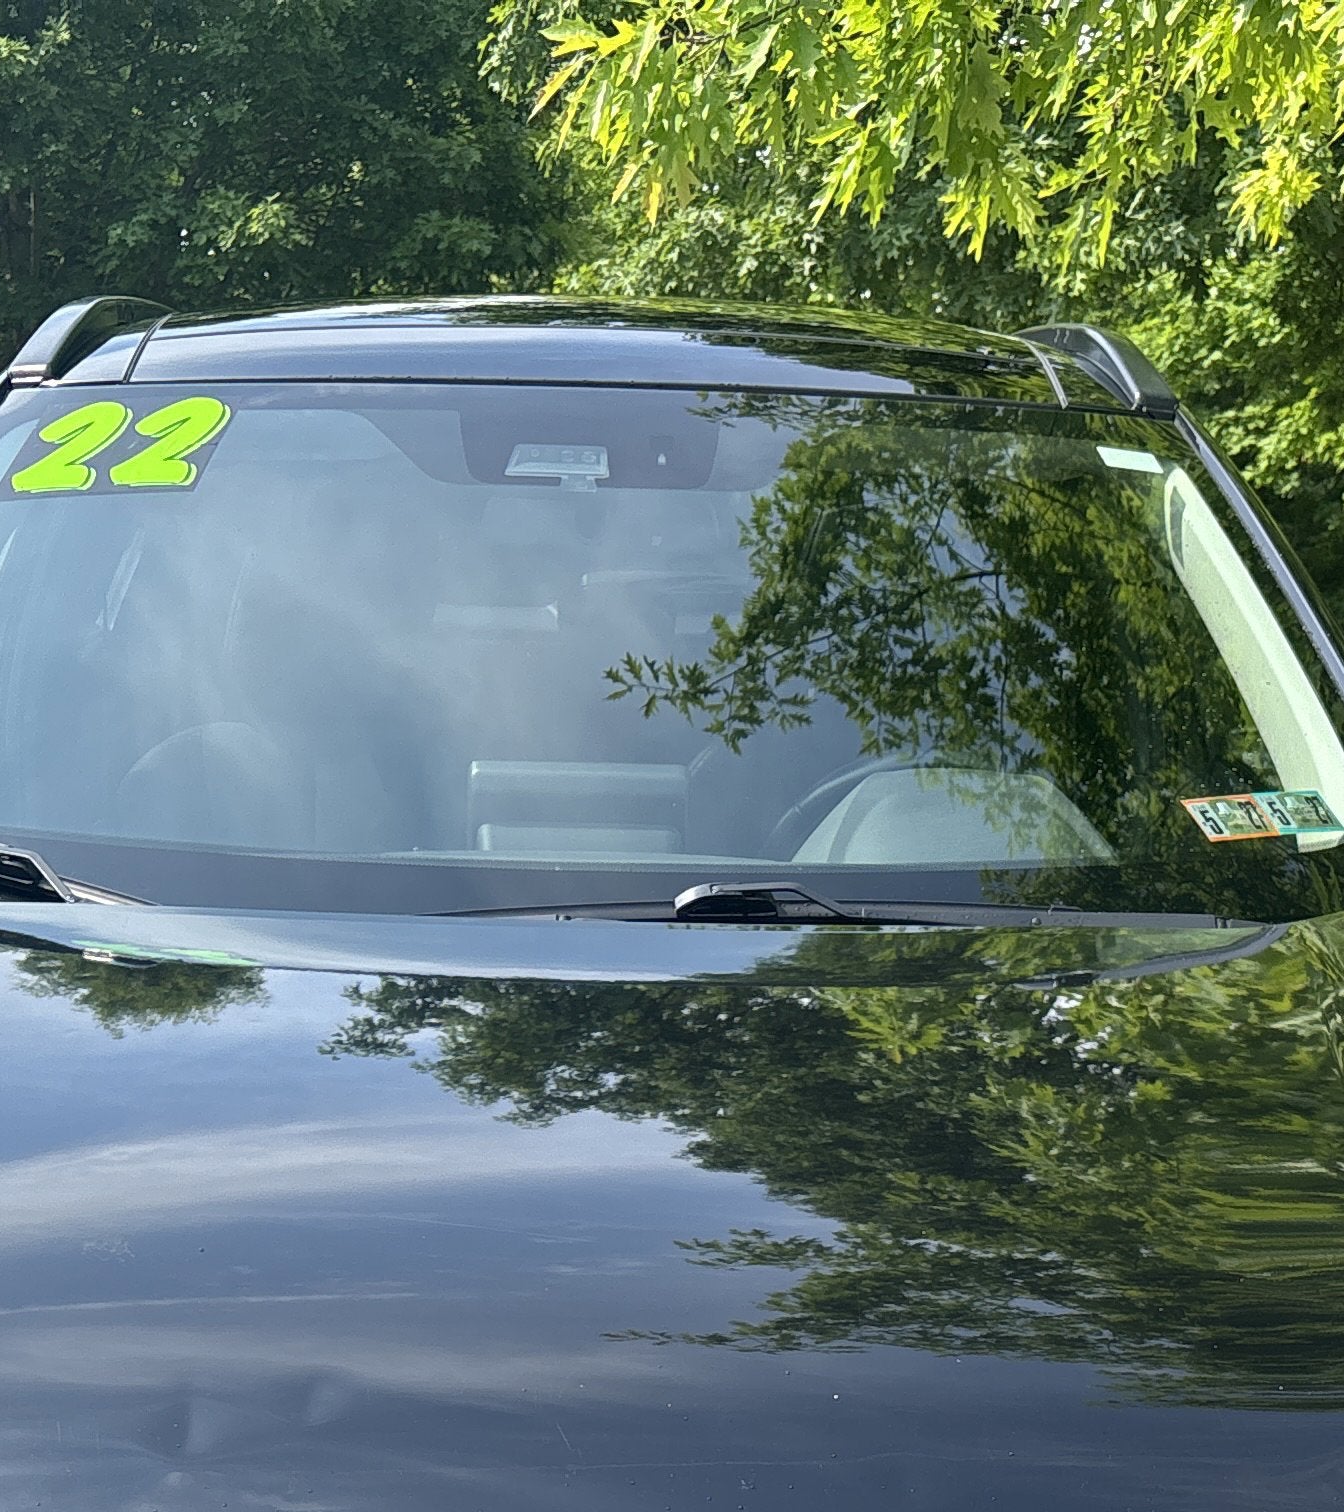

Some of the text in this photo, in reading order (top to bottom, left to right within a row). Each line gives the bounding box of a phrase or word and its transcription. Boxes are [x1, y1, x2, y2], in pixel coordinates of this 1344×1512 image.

[11, 397, 232, 493] 22
[1198, 808, 1225, 835] 5
[1266, 801, 1292, 826] 5
